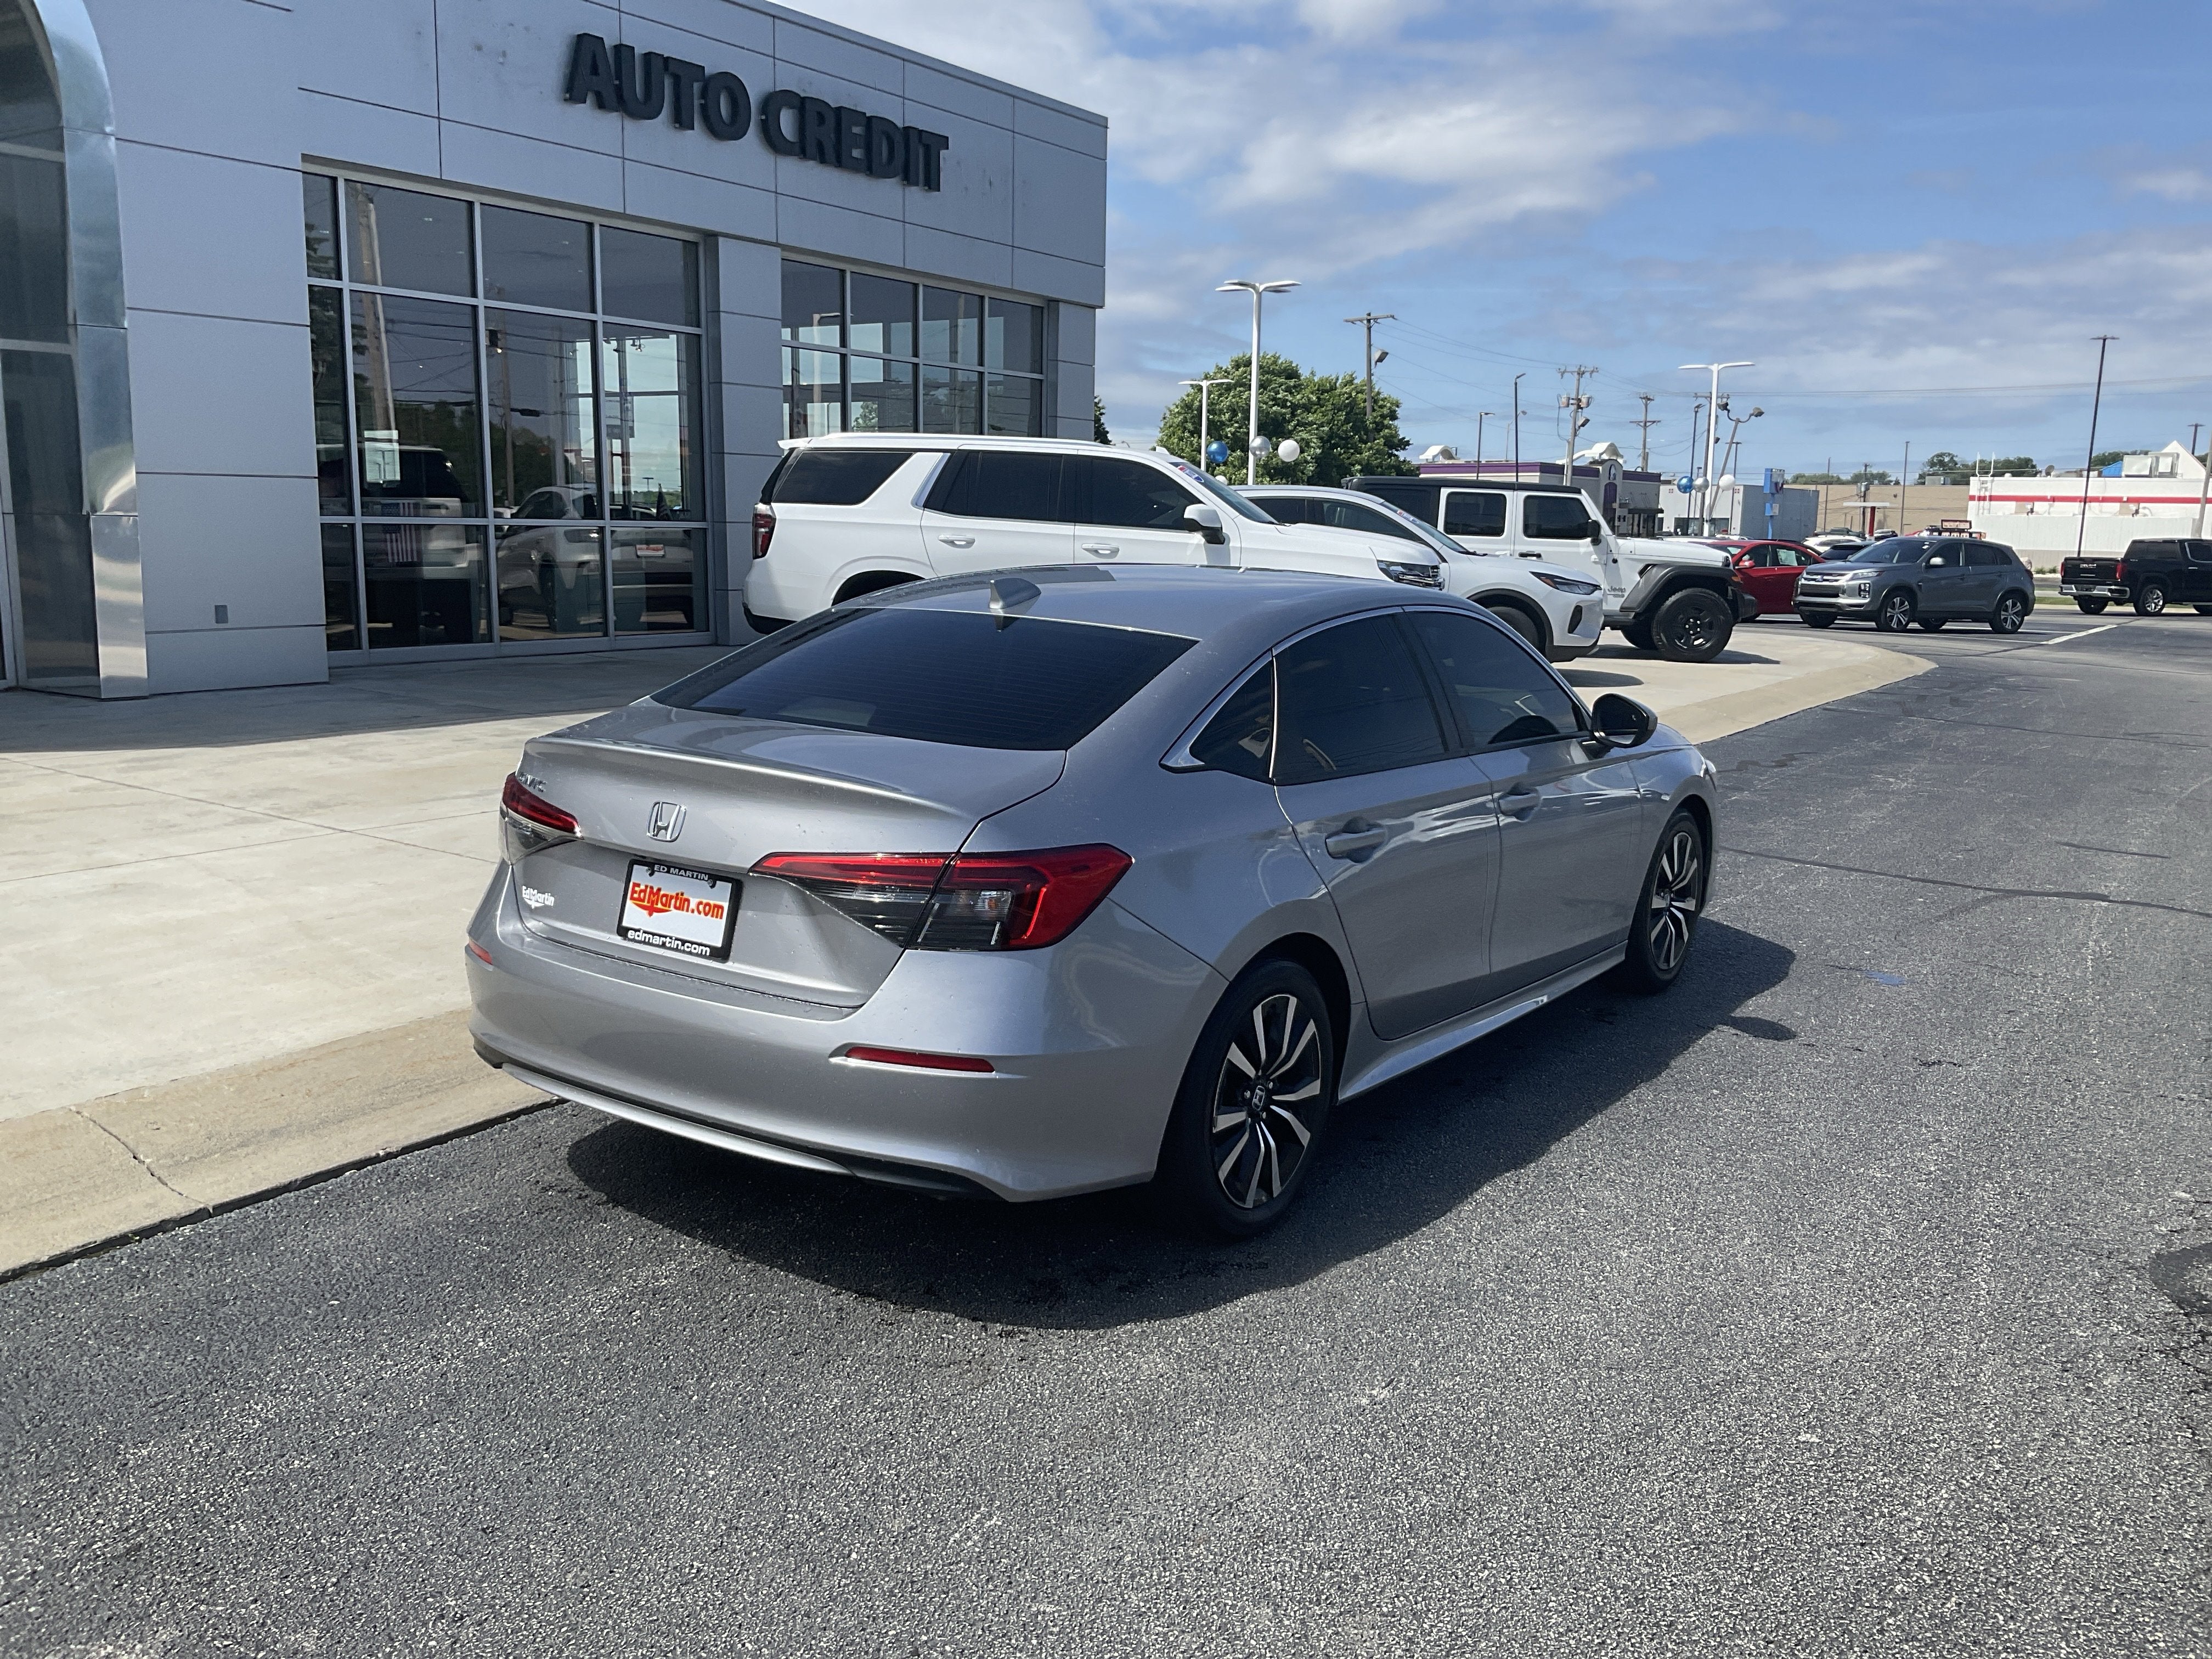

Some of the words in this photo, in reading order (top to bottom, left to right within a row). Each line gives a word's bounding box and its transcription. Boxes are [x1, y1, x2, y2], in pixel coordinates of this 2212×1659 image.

[564, 32, 752, 141] AUTO
[761, 89, 949, 192] CREDIT
[670, 867, 708, 881] MARTIN
[630, 881, 724, 919] EdMartin.com
[628, 929, 710, 956] edmartin.com
